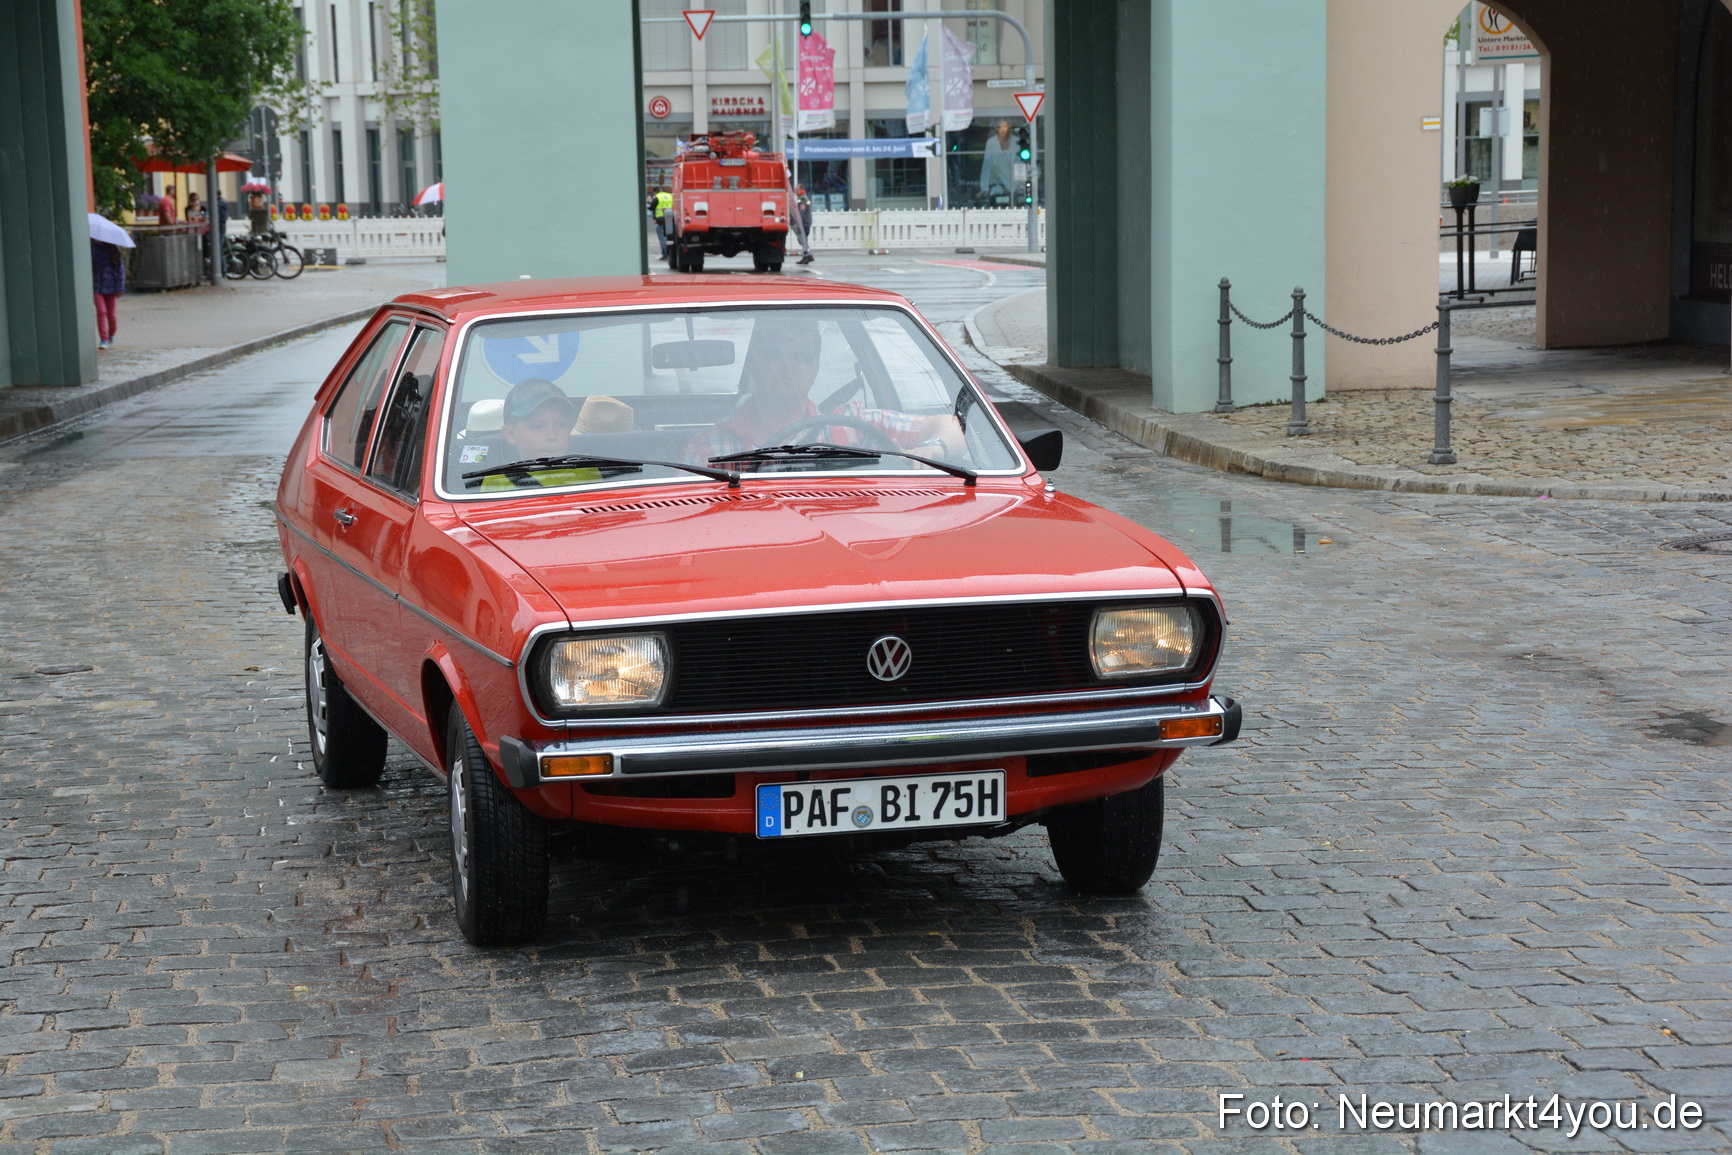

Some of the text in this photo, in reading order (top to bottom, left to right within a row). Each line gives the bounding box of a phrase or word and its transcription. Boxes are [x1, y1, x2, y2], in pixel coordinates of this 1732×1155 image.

[711, 97, 764, 105] KIRSCH &
[712, 107, 765, 115] HAUBNER
[782, 787, 852, 829] PAF
[765, 816, 775, 827] D
